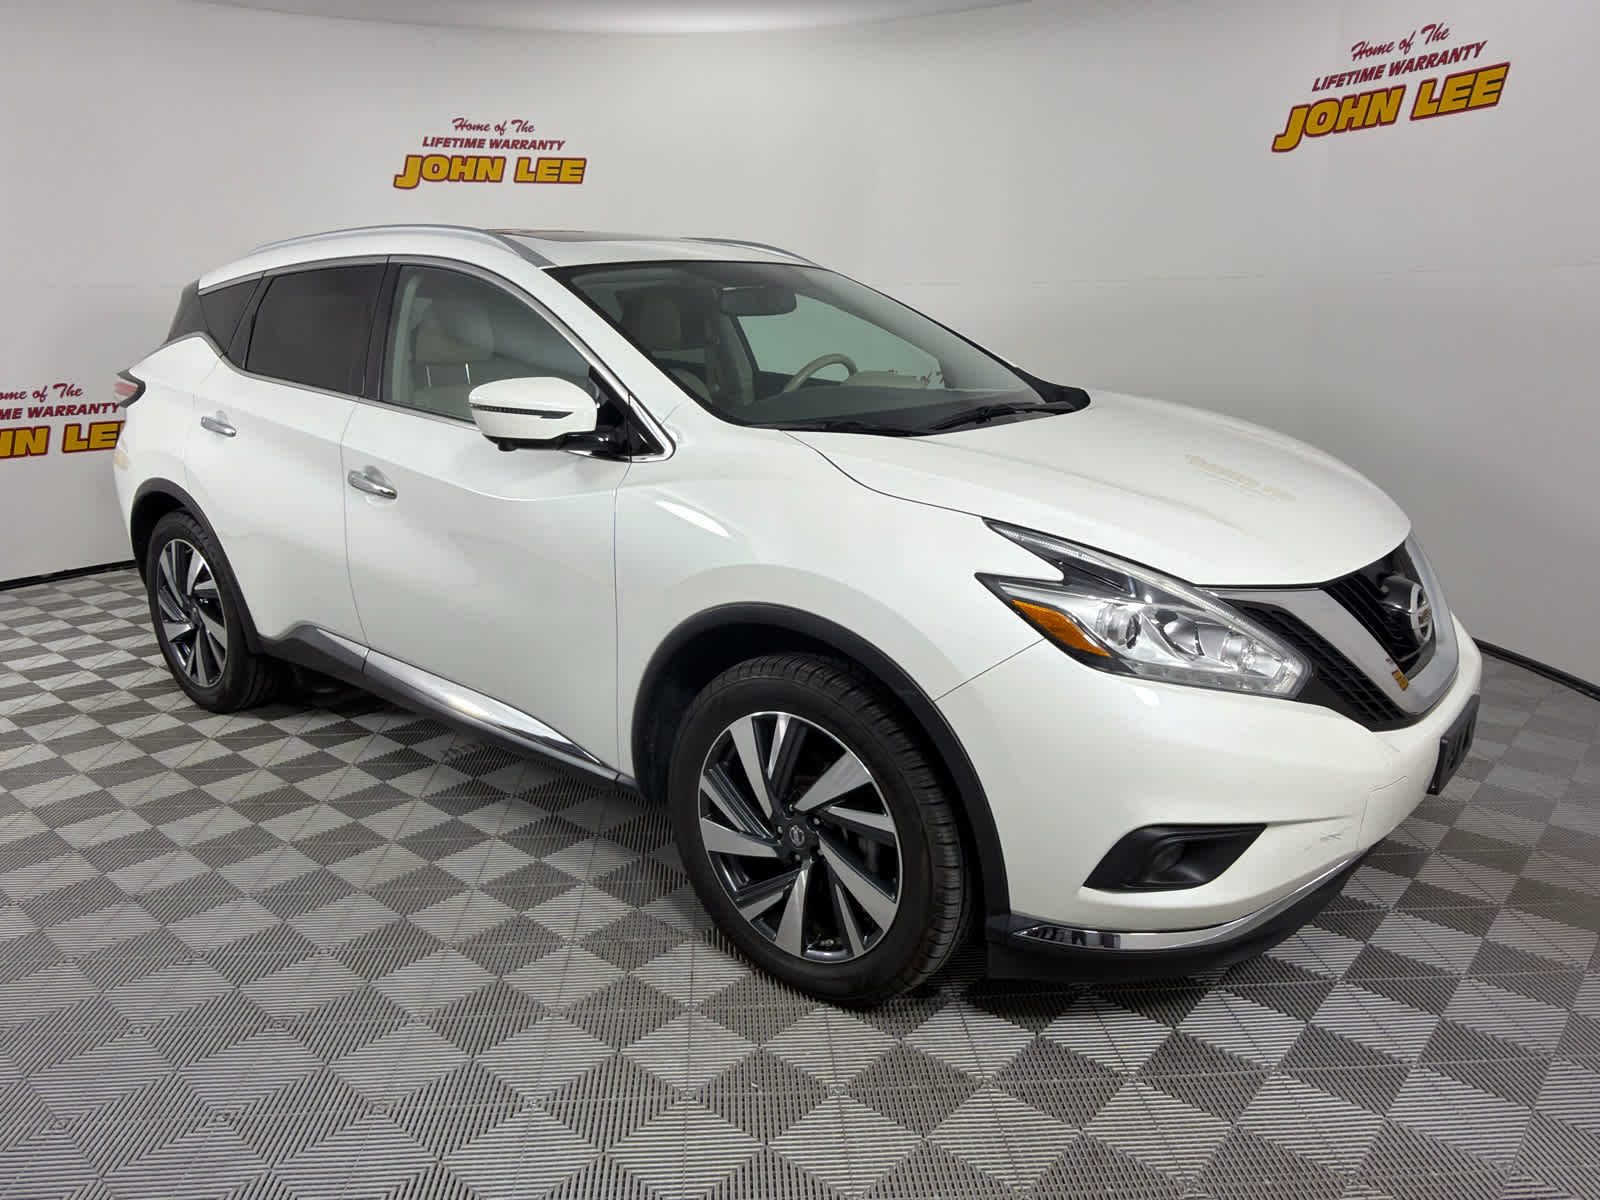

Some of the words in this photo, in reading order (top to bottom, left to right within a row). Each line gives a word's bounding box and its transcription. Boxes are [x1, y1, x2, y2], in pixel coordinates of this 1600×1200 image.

[1351, 41, 1395, 61] Home
[1398, 31, 1416, 54] of
[1421, 23, 1450, 44] The
[1312, 64, 1385, 92] LIFETIME
[1389, 41, 1488, 76] WARRANTY
[1271, 84, 1407, 153] JOHN
[1409, 61, 1511, 121] LEE
[451, 117, 491, 132] Home
[494, 120, 508, 136] of
[511, 119, 536, 133] The
[422, 136, 487, 149] LIFETIME
[489, 138, 566, 151] WARRANTY
[393, 154, 506, 190] JOHN
[513, 156, 587, 185] LEE
[0, 390, 27, 401] ome
[32, 385, 48, 403] of
[52, 383, 84, 398] The
[27, 402, 121, 418] WARRANTY
[62, 420, 126, 453] LE
